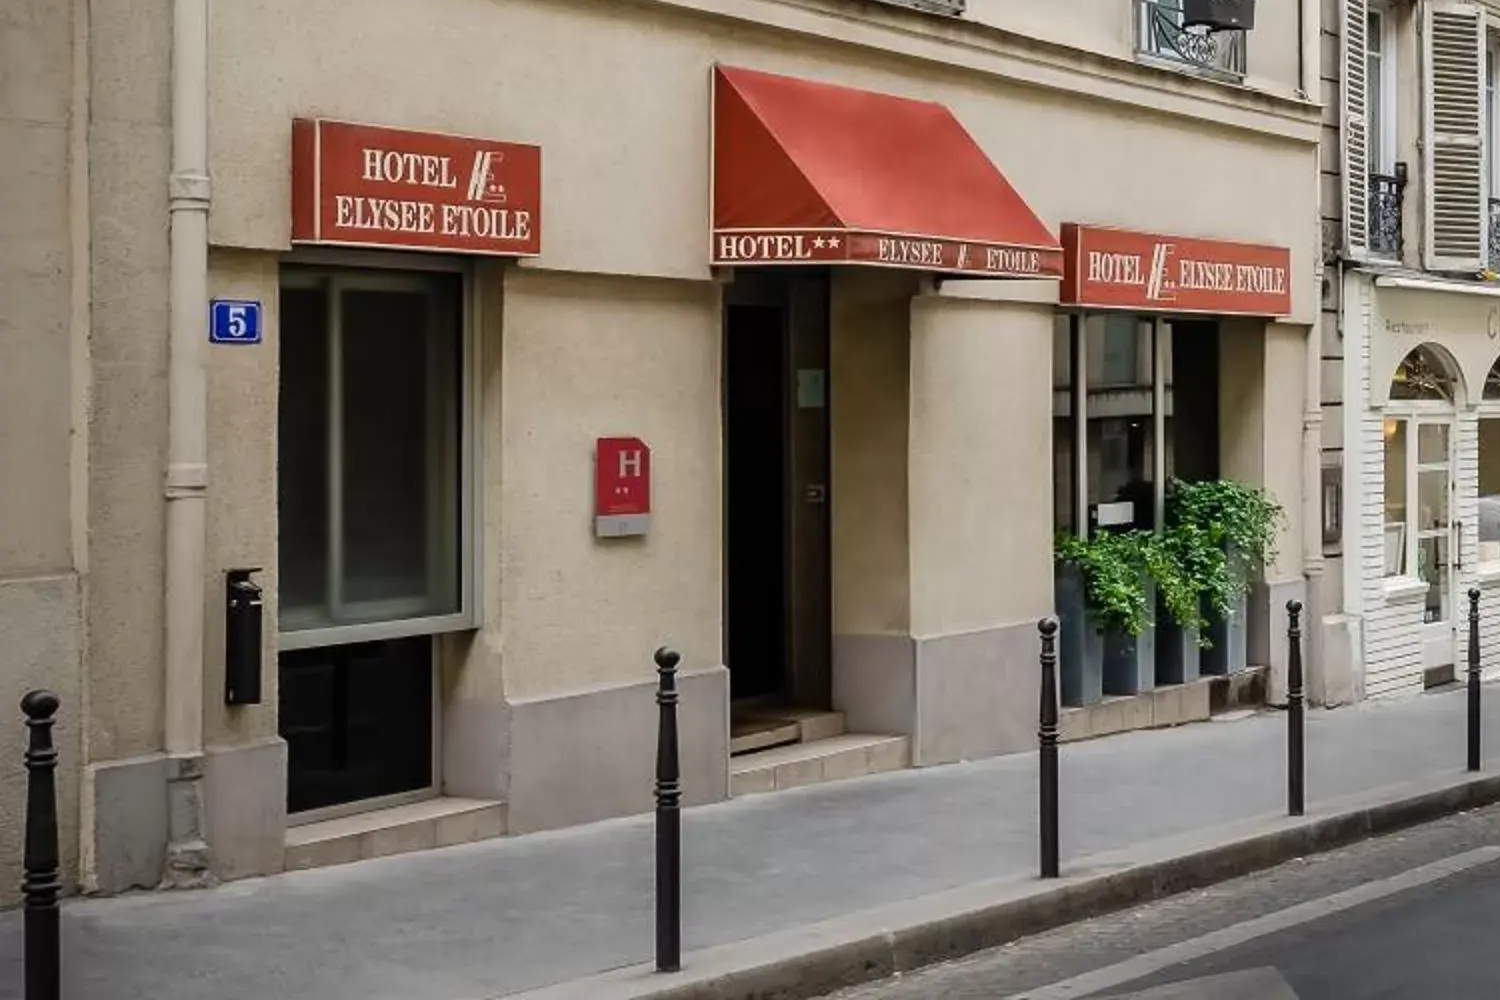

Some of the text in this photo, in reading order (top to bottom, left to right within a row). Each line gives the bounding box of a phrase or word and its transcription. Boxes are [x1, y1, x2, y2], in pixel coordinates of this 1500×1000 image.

[362, 149, 457, 188] HOTEL
[335, 195, 531, 241] ELYSEE ETOILE
[719, 235, 811, 259] HOTEL
[878, 238, 943, 265] ELYSEE
[986, 247, 1040, 273] ETOILE
[1088, 251, 1145, 285] HOTEL
[1179, 259, 1234, 292] ELYSEE
[1236, 264, 1286, 294] ETOILE
[228, 307, 246, 338] 5
[618, 450, 641, 478] H
